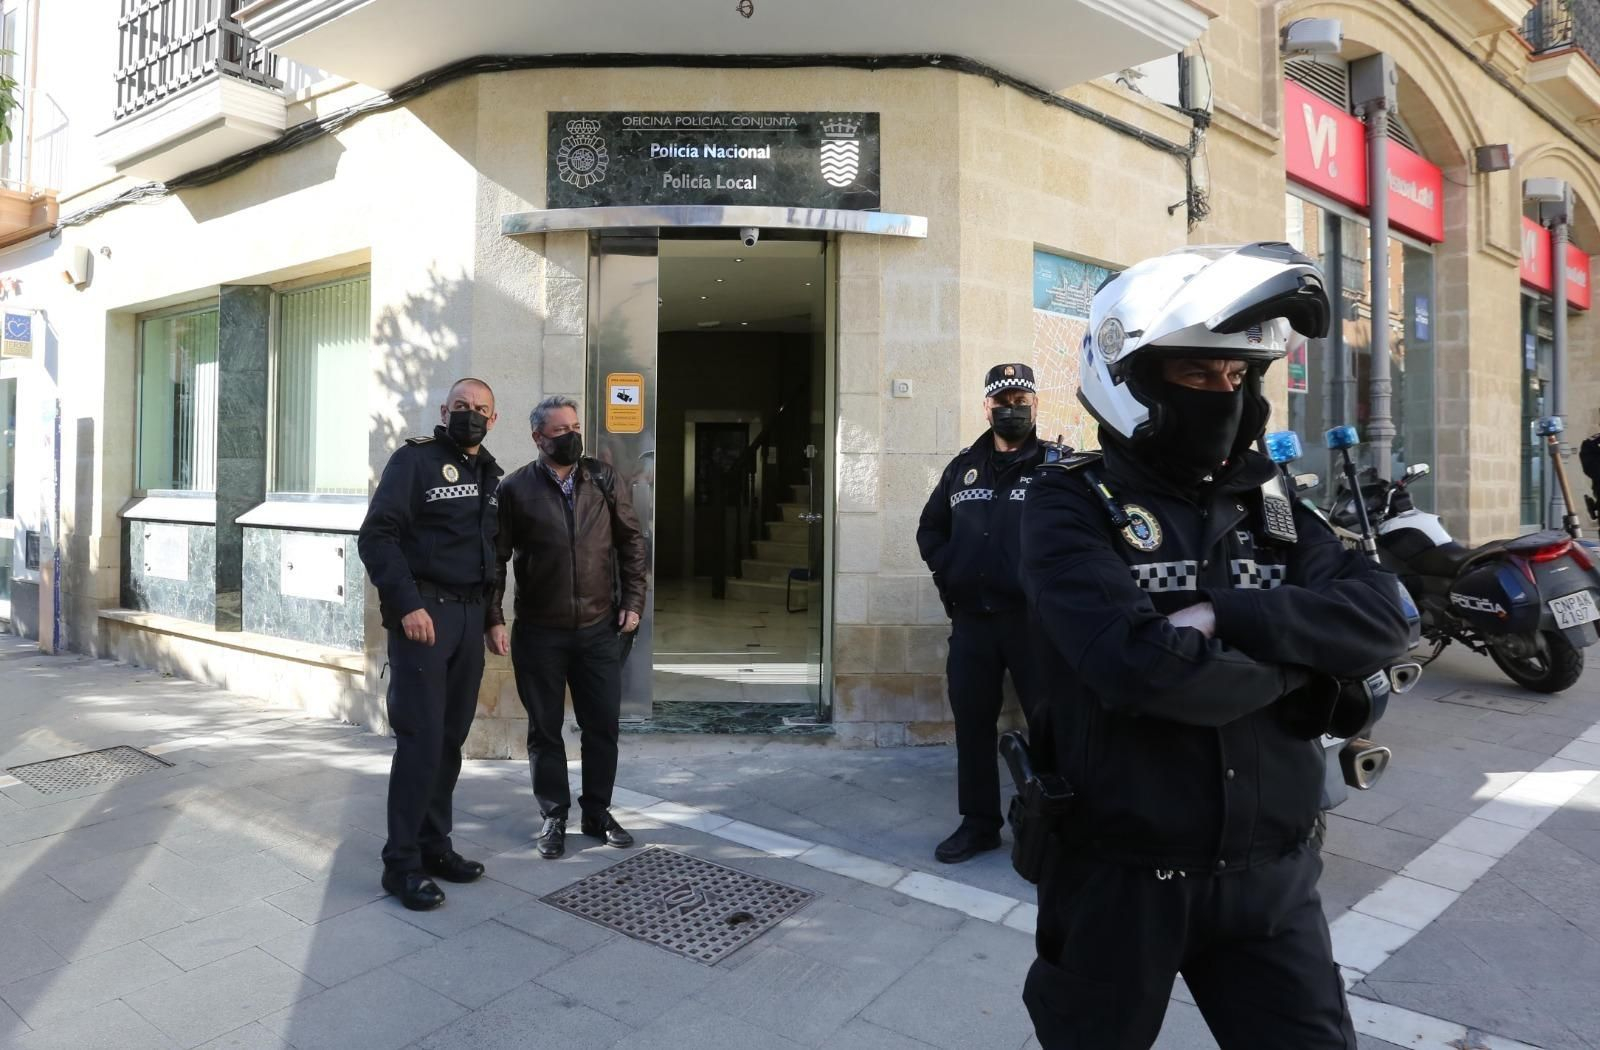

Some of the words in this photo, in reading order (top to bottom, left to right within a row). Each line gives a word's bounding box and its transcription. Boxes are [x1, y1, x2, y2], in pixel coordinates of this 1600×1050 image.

[622, 116, 672, 126] OFICINA
[675, 116, 729, 126] POLICIAL
[731, 116, 798, 128] CONJUNTA
[650, 143, 700, 158] Policía
[703, 143, 771, 159] Nacional
[663, 173, 712, 189] Policía
[716, 174, 757, 190] Local
[1561, 606, 1590, 622] 4197
